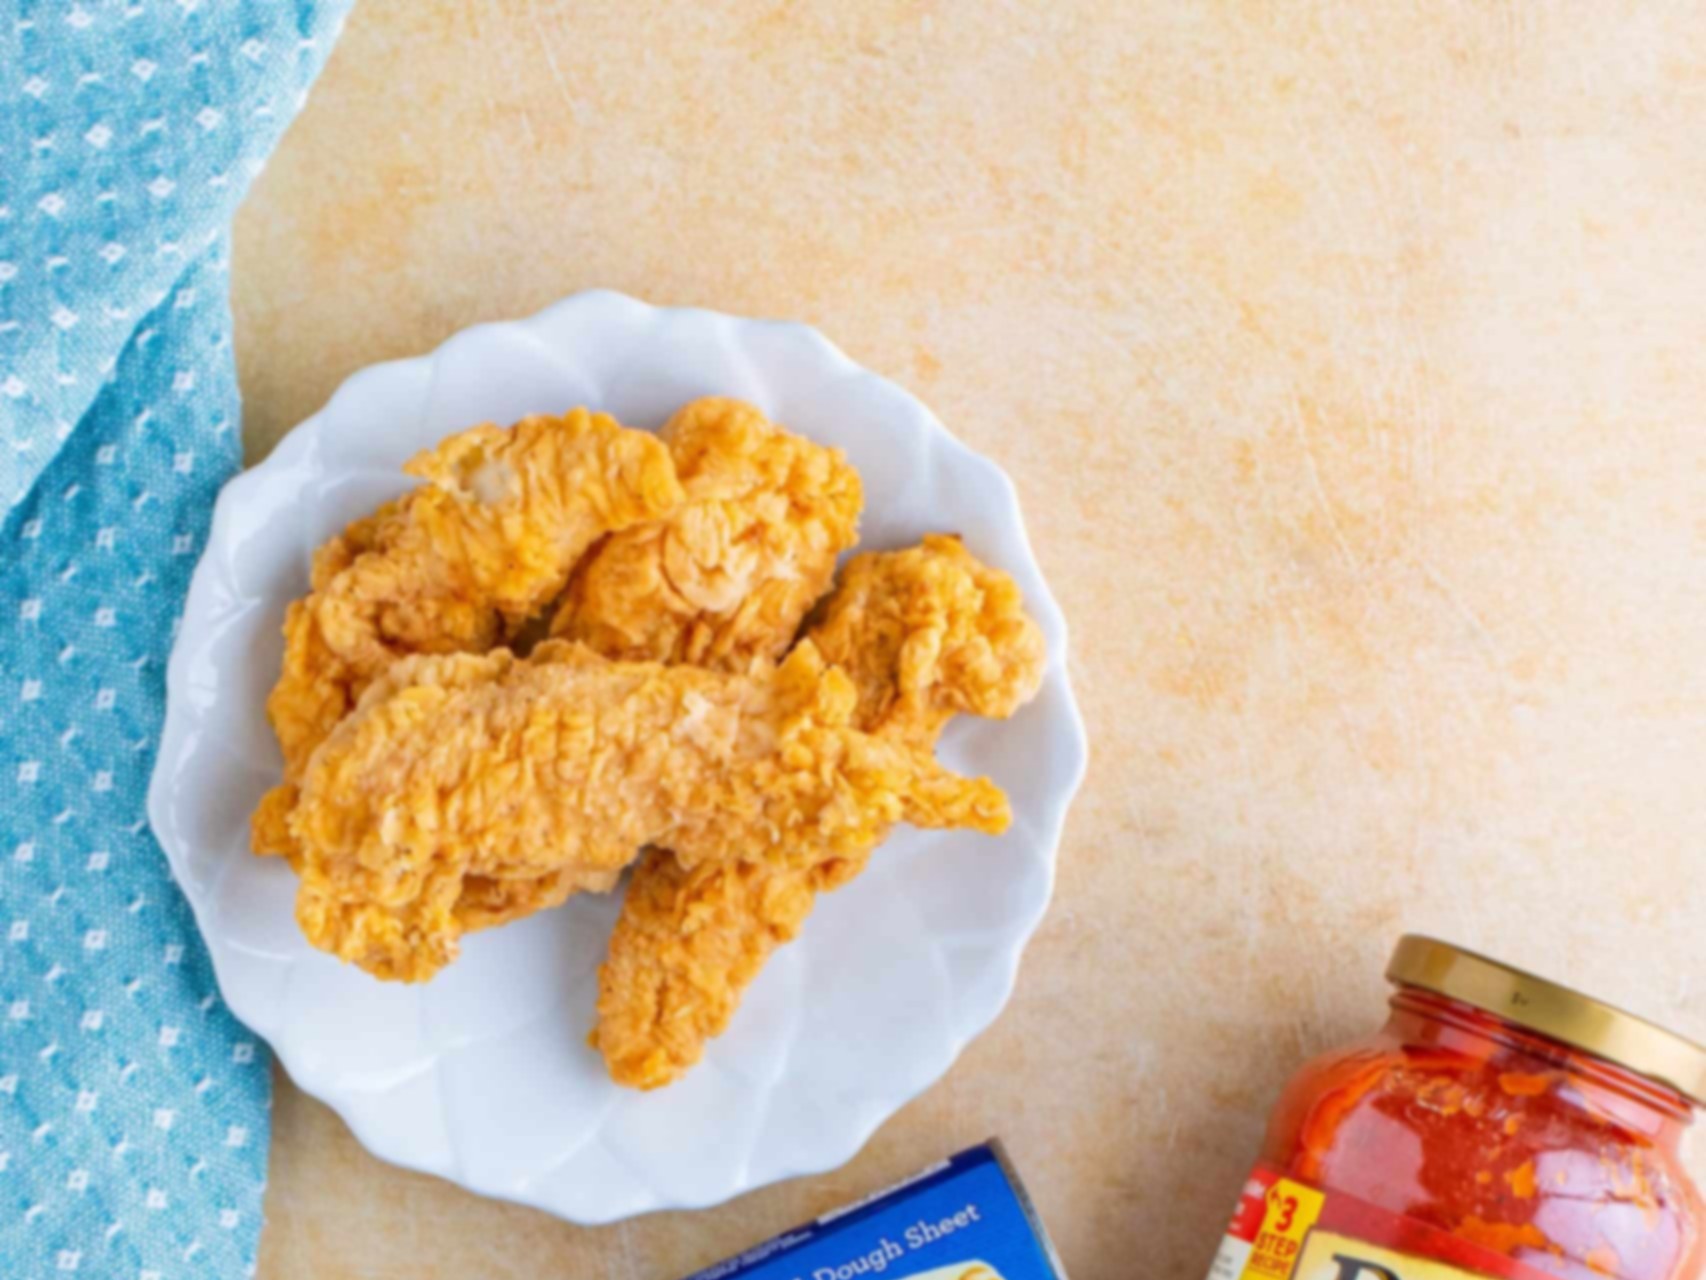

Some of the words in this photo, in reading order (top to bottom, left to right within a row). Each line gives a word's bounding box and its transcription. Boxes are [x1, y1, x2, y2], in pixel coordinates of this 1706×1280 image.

[903, 1202, 981, 1250] Sheet
[1274, 1195, 1298, 1232] 3
[1255, 1231, 1299, 1257] STEP
